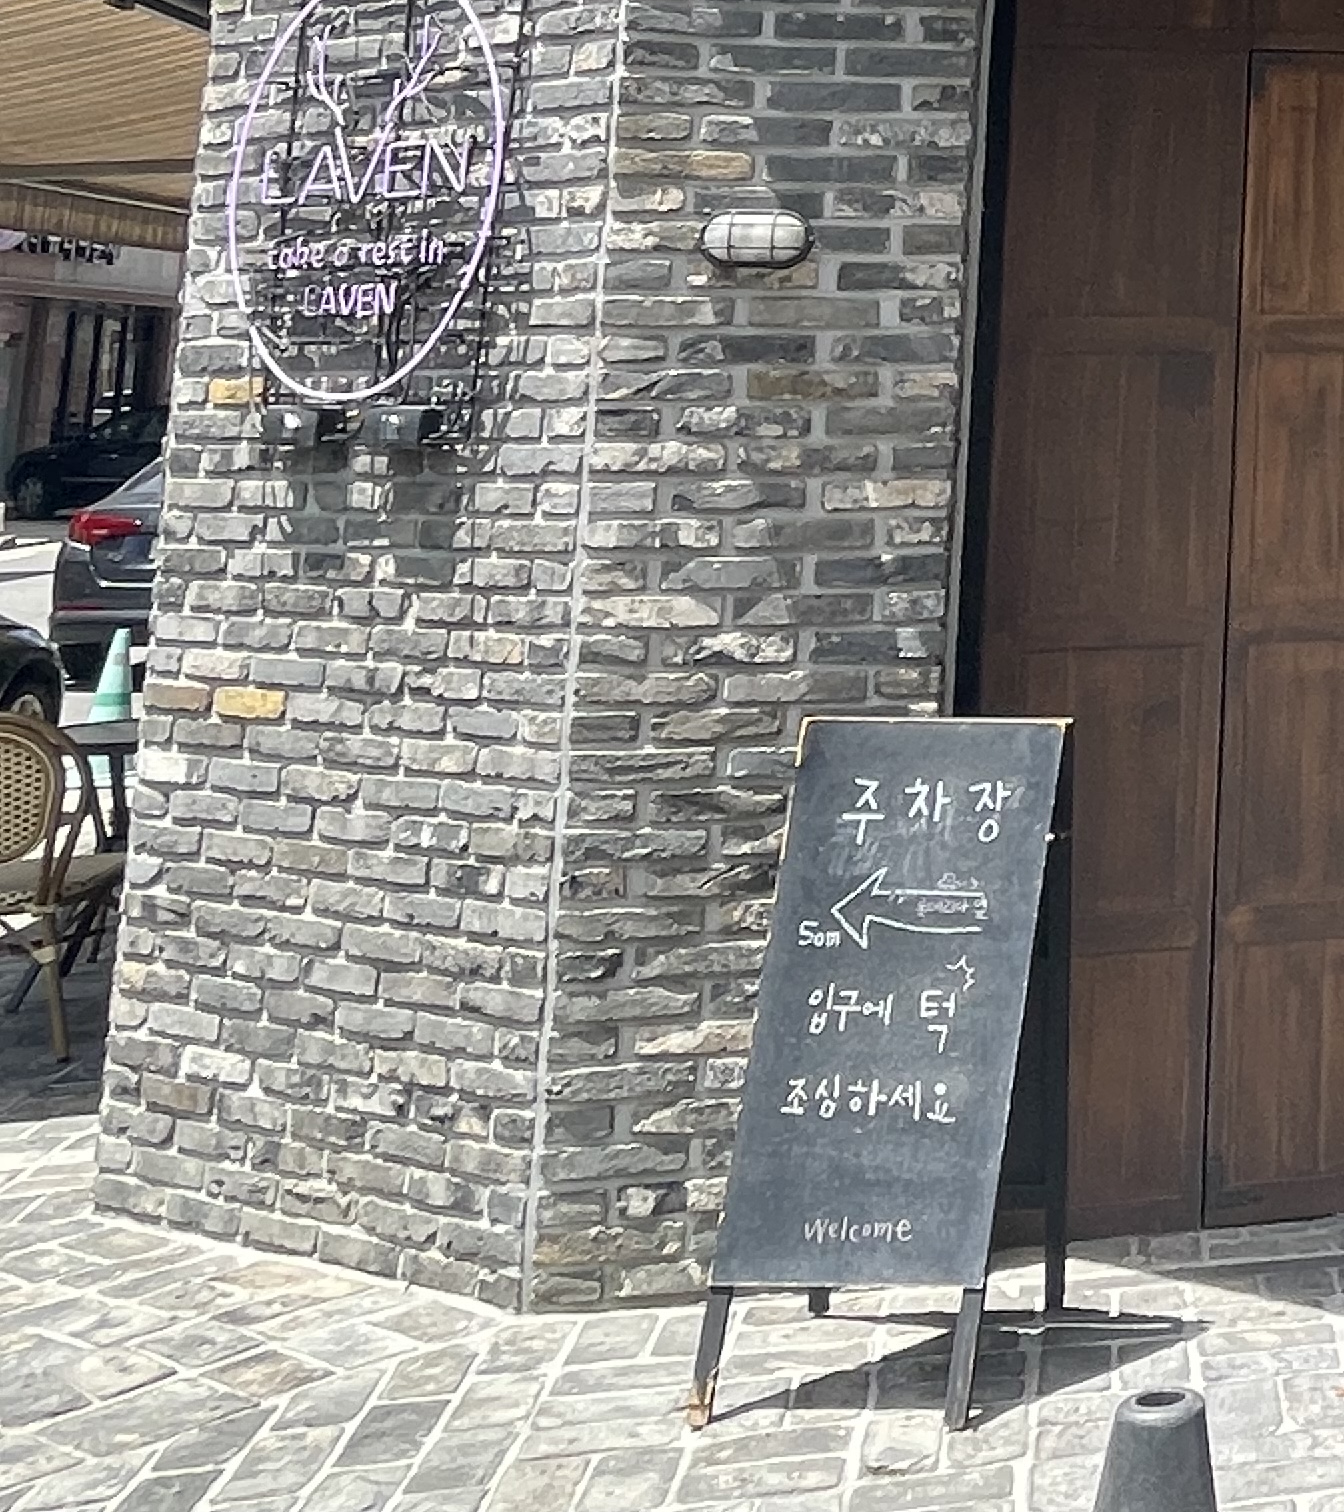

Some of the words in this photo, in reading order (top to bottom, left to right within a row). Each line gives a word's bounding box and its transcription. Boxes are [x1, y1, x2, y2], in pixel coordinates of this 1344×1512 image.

[262, 122, 472, 206] LAVEN
[303, 281, 398, 319] LAVEN
[808, 982, 894, 1034] 입구에
[919, 990, 956, 1054] 턱
[780, 1074, 956, 1124] 조심하세요
[804, 1216, 912, 1244] Welcome
